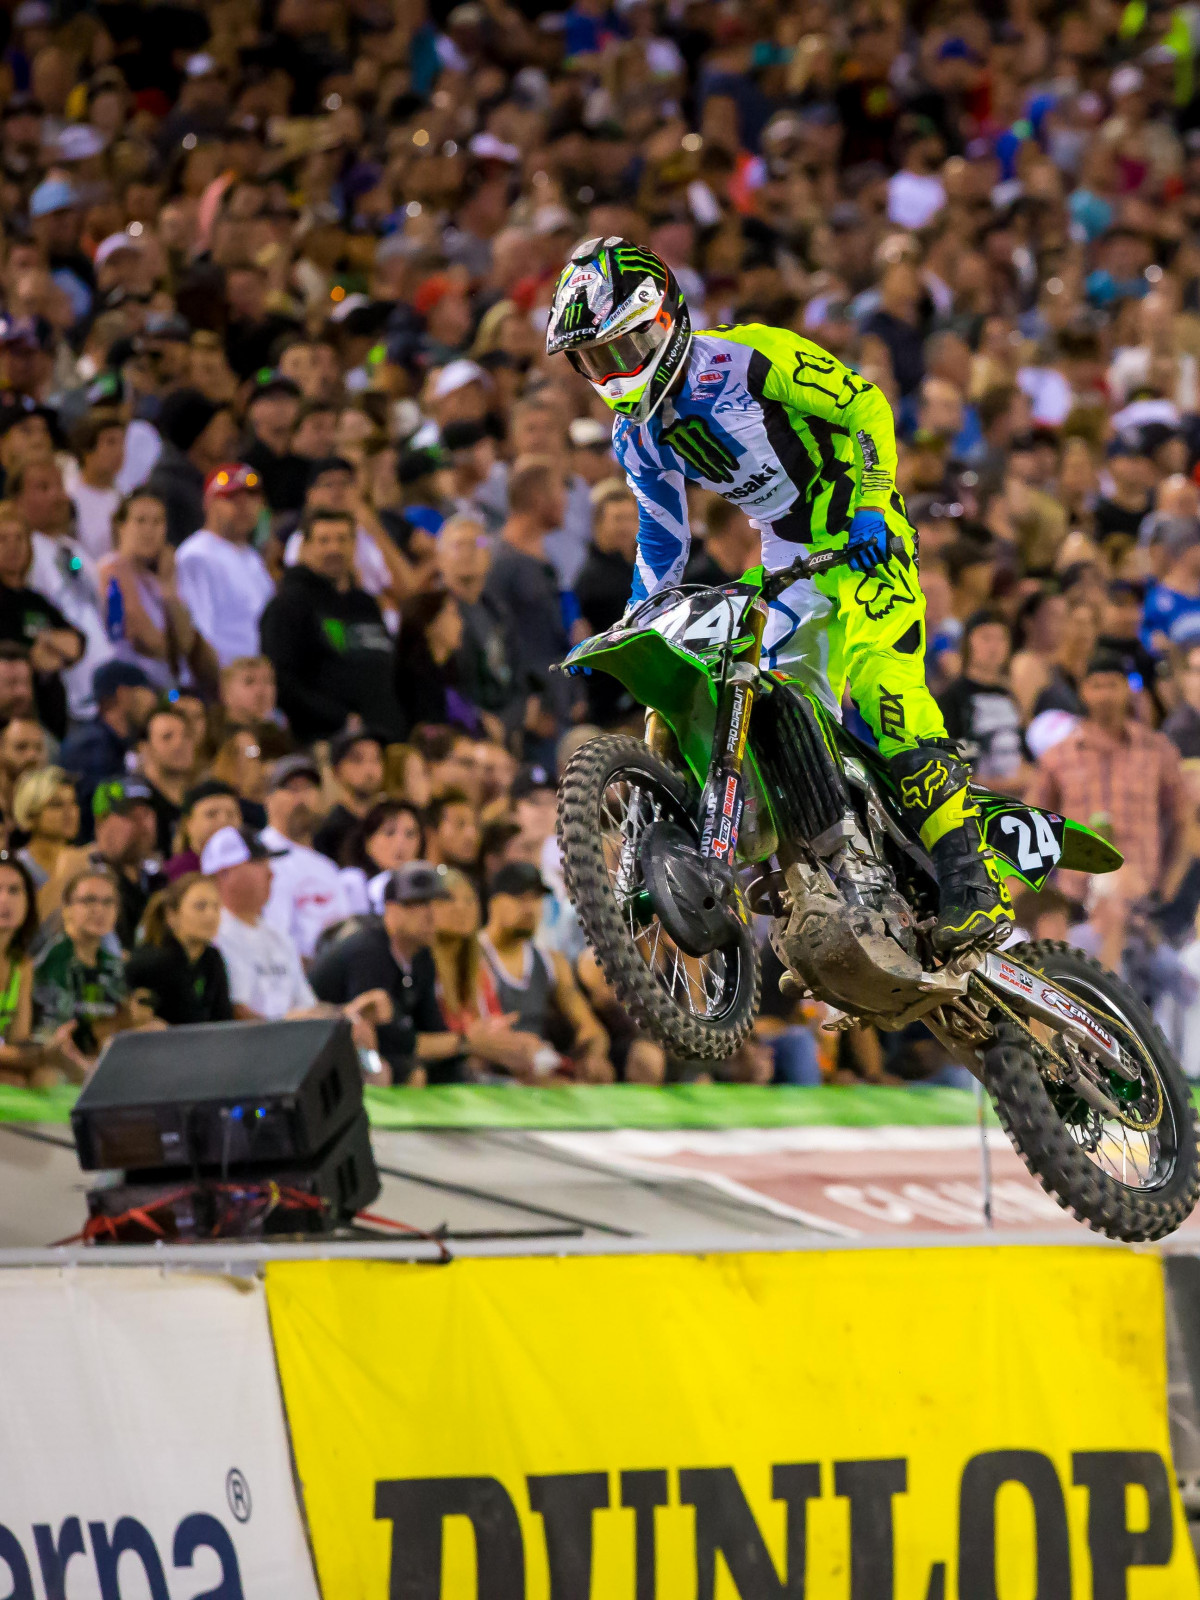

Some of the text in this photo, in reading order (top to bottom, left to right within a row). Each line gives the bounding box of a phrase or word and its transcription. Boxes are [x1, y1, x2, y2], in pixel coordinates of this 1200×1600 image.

[549, 327, 597, 348] MONSTER
[665, 315, 688, 368] MONSTER
[699, 374, 723, 383] BELL
[720, 463, 779, 500] asaki
[808, 552, 834, 567] ARC
[726, 685, 744, 753] PRO CIRCUIT
[878, 683, 906, 743] FOX
[723, 776, 737, 818] BRAKING
[701, 792, 718, 858] DUNLOP
[1000, 811, 1061, 871] 24
[999, 972, 1033, 994] BRAKING
[1001, 963, 1016, 976] RK
[374, 1448, 1175, 1600] DUNLOP
